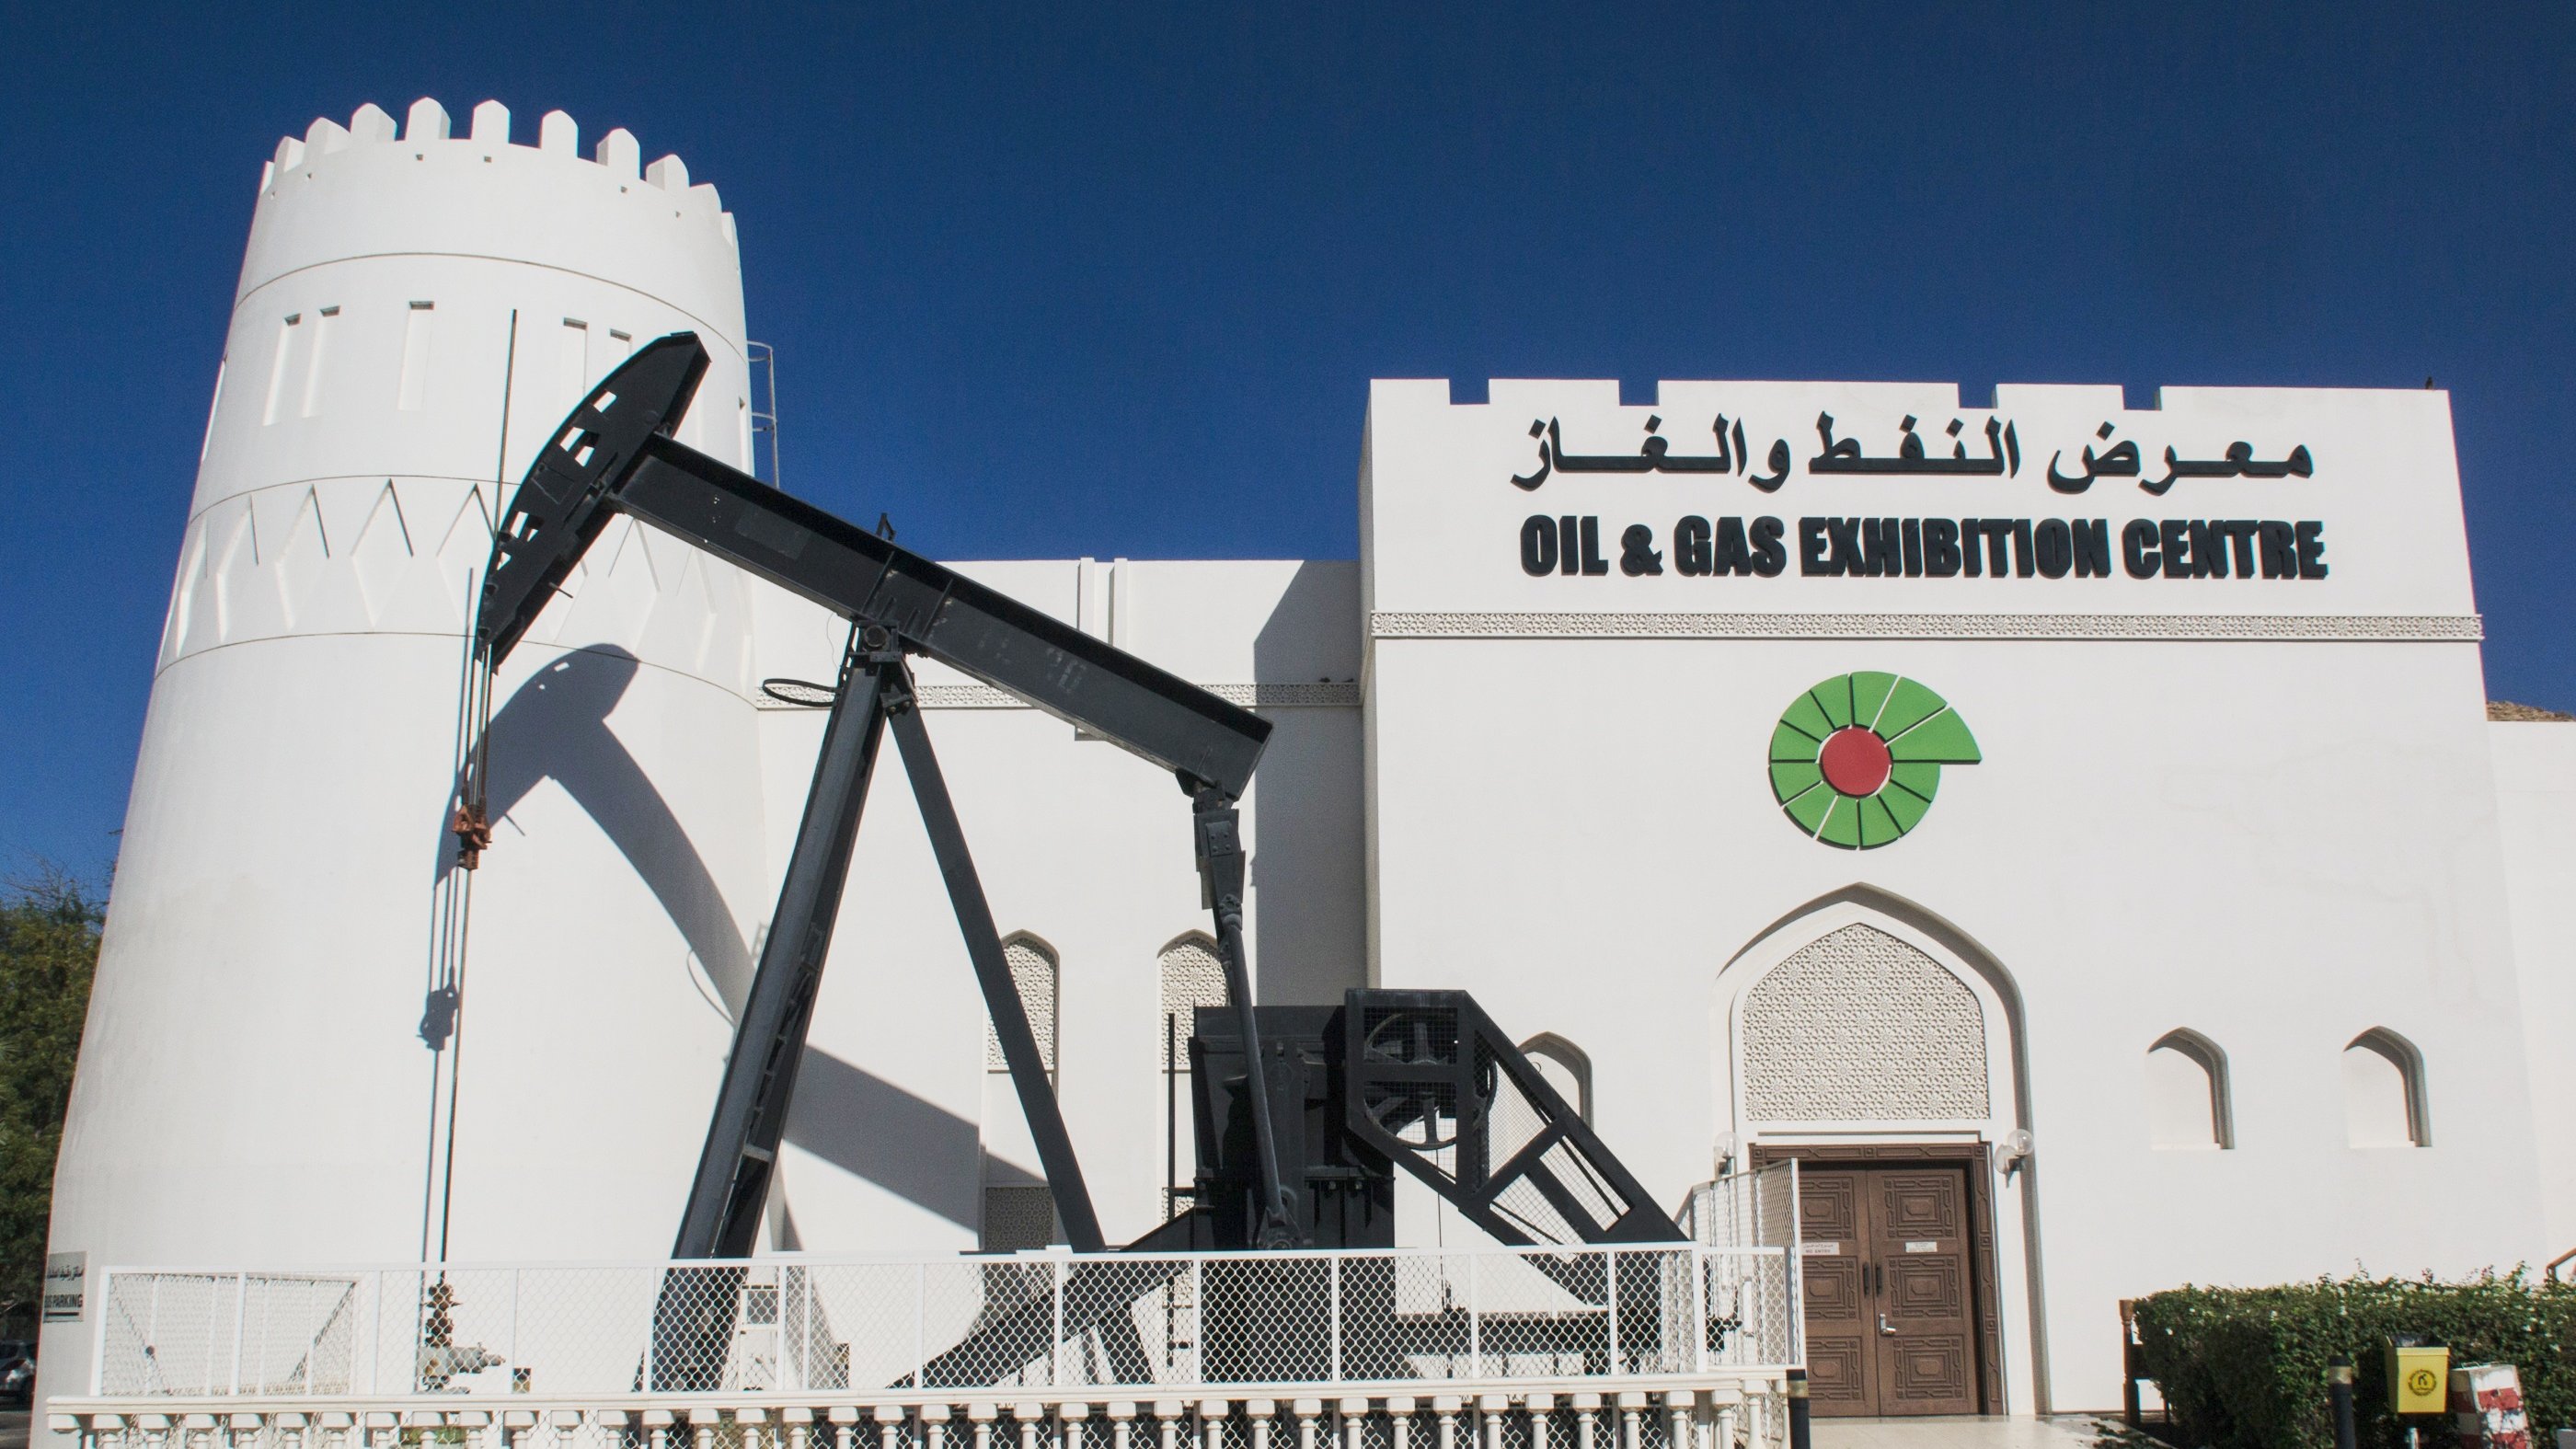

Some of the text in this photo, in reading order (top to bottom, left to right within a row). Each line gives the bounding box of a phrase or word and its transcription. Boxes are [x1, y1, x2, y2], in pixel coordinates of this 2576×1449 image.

[1511, 411, 2313, 496] معرض النفط والغاز
[1521, 515, 2328, 580] OIL & GAS EXHIBITION CENTRE
[53, 1294, 83, 1307] PARKING
